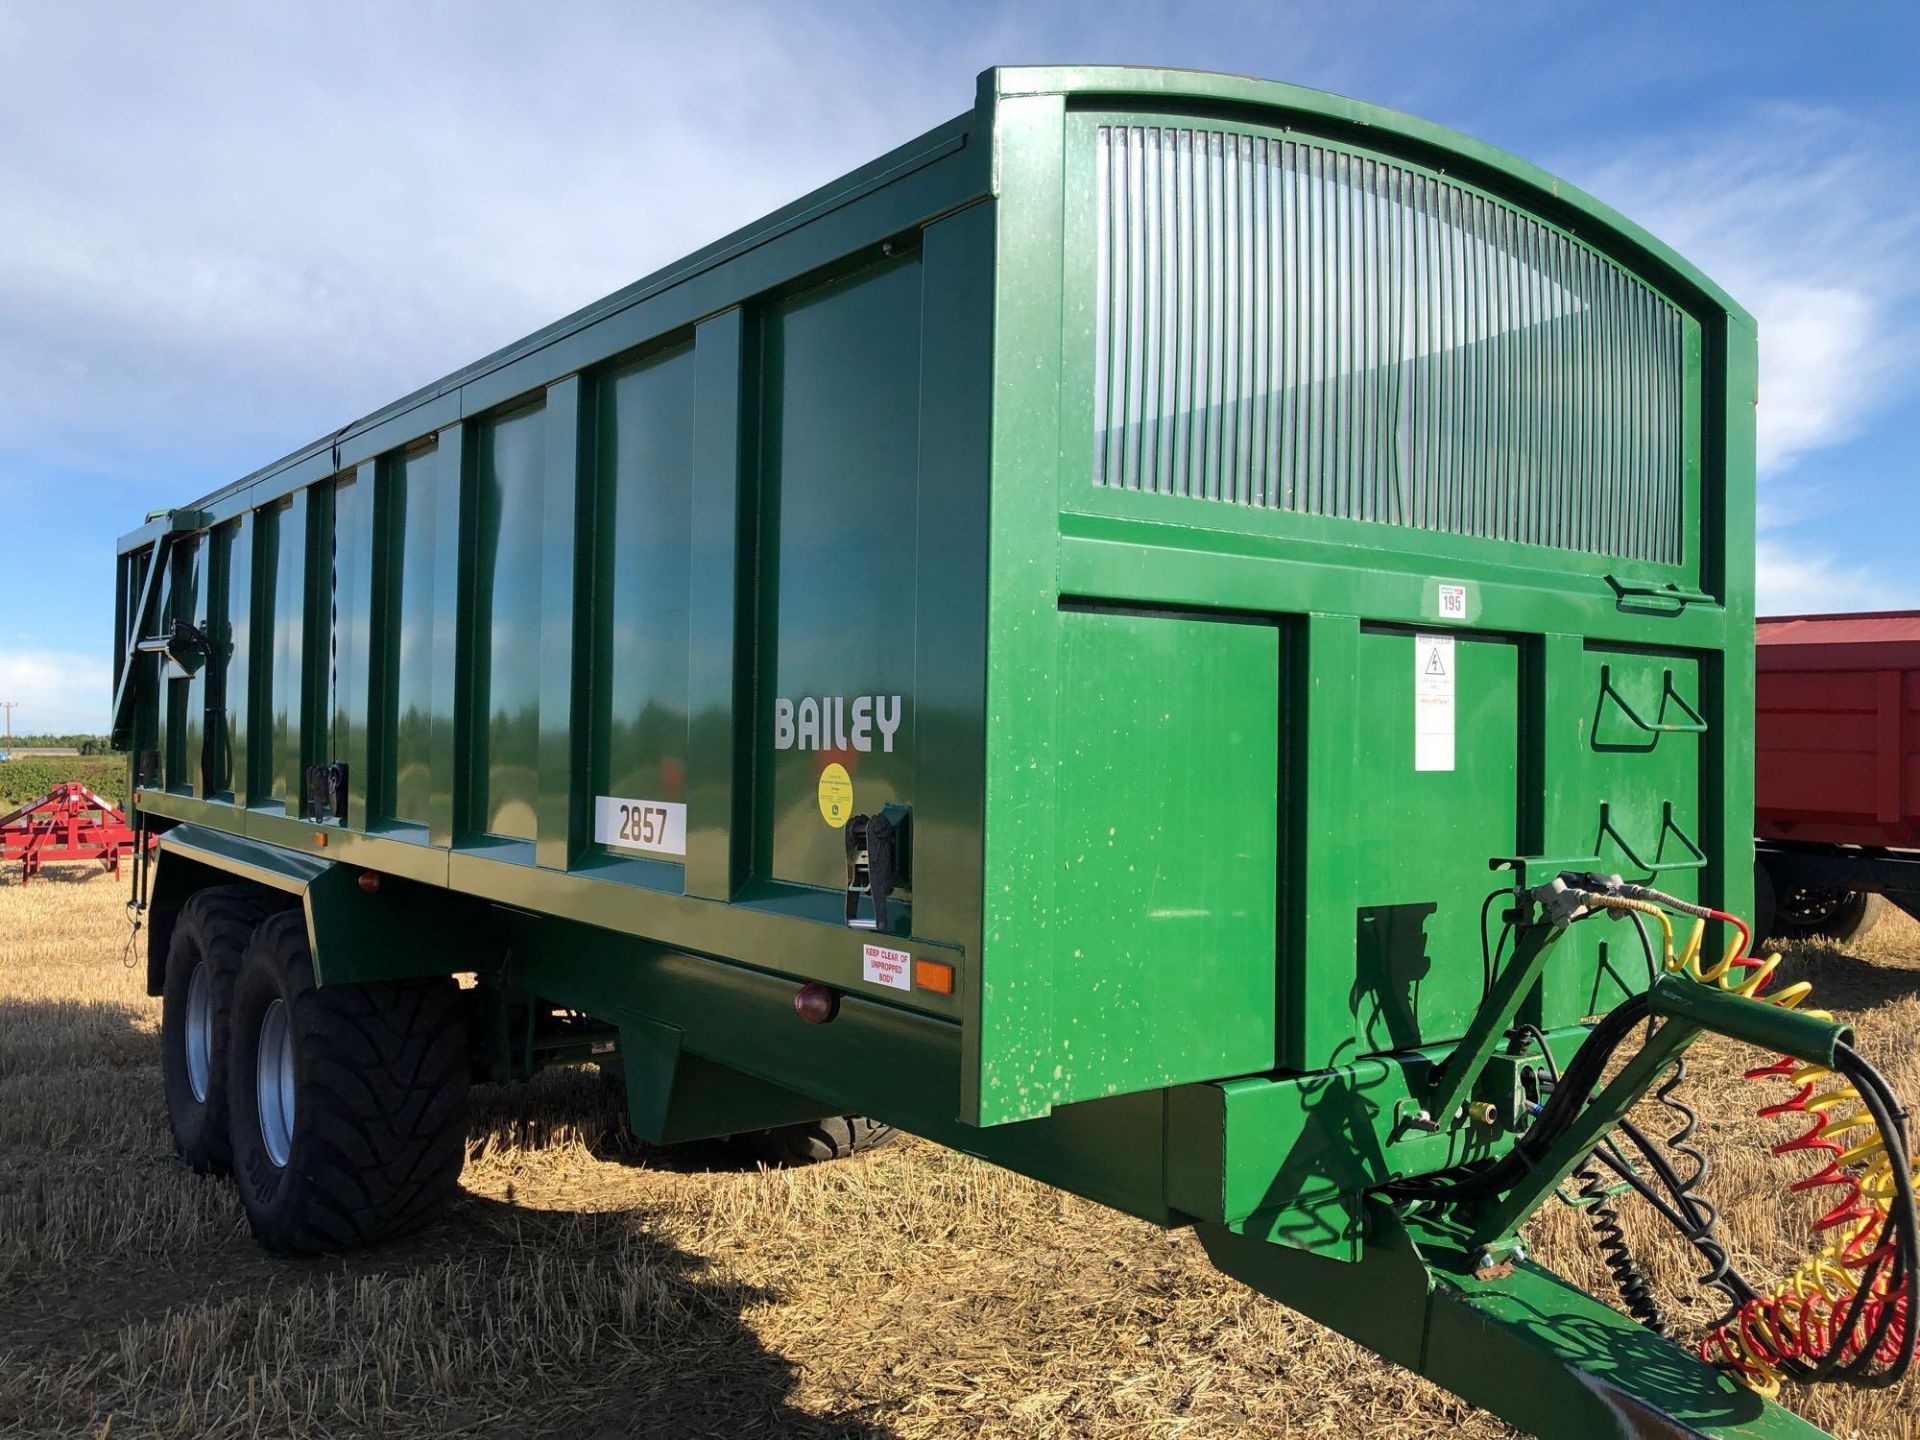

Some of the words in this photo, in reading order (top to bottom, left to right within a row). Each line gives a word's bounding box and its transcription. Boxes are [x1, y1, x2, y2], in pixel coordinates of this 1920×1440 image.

[1444, 595, 1461, 611] 195
[775, 696, 901, 752] BAILEY
[620, 805, 667, 845] 2857
[866, 947, 879, 957] KEEP
[881, 951, 899, 961] CLEAR
[879, 973, 894, 983] BODY
